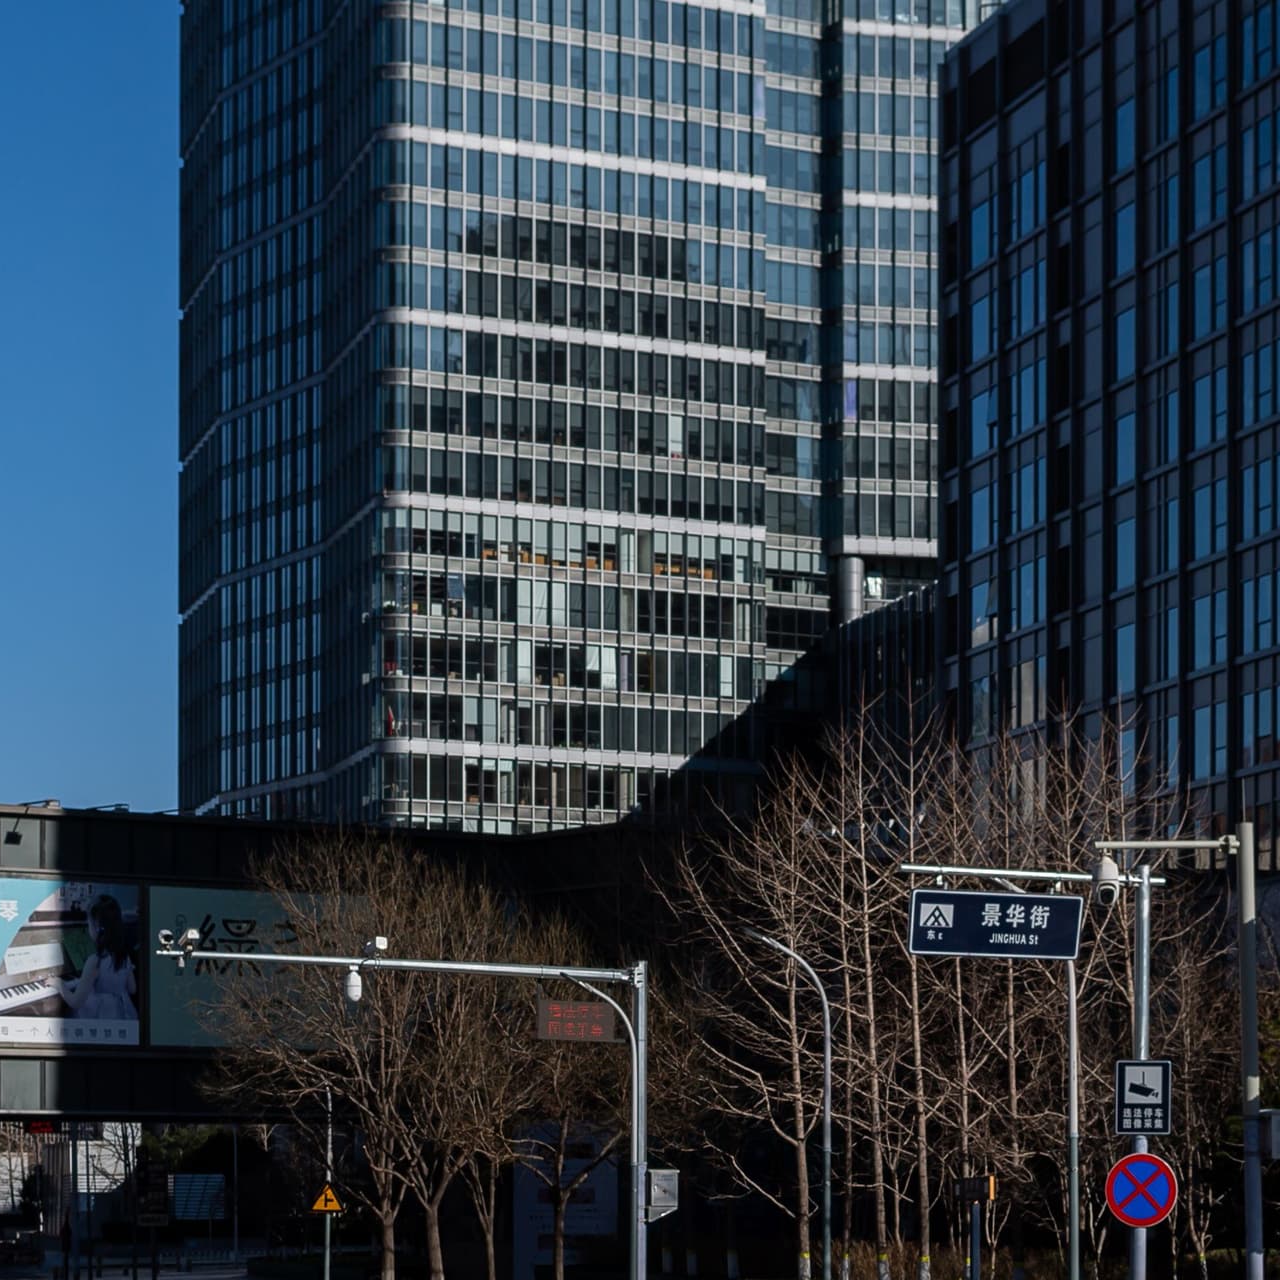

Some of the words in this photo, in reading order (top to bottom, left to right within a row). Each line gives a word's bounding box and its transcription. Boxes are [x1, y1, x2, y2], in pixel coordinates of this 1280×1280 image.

[981, 903, 1051, 929] 景华街
[989, 932, 1027, 944] JINGHUA
[1028, 934, 1039, 945] St
[1123, 1108, 1163, 1118] 违法停车
[1123, 1118, 1163, 1128] 图像采集
